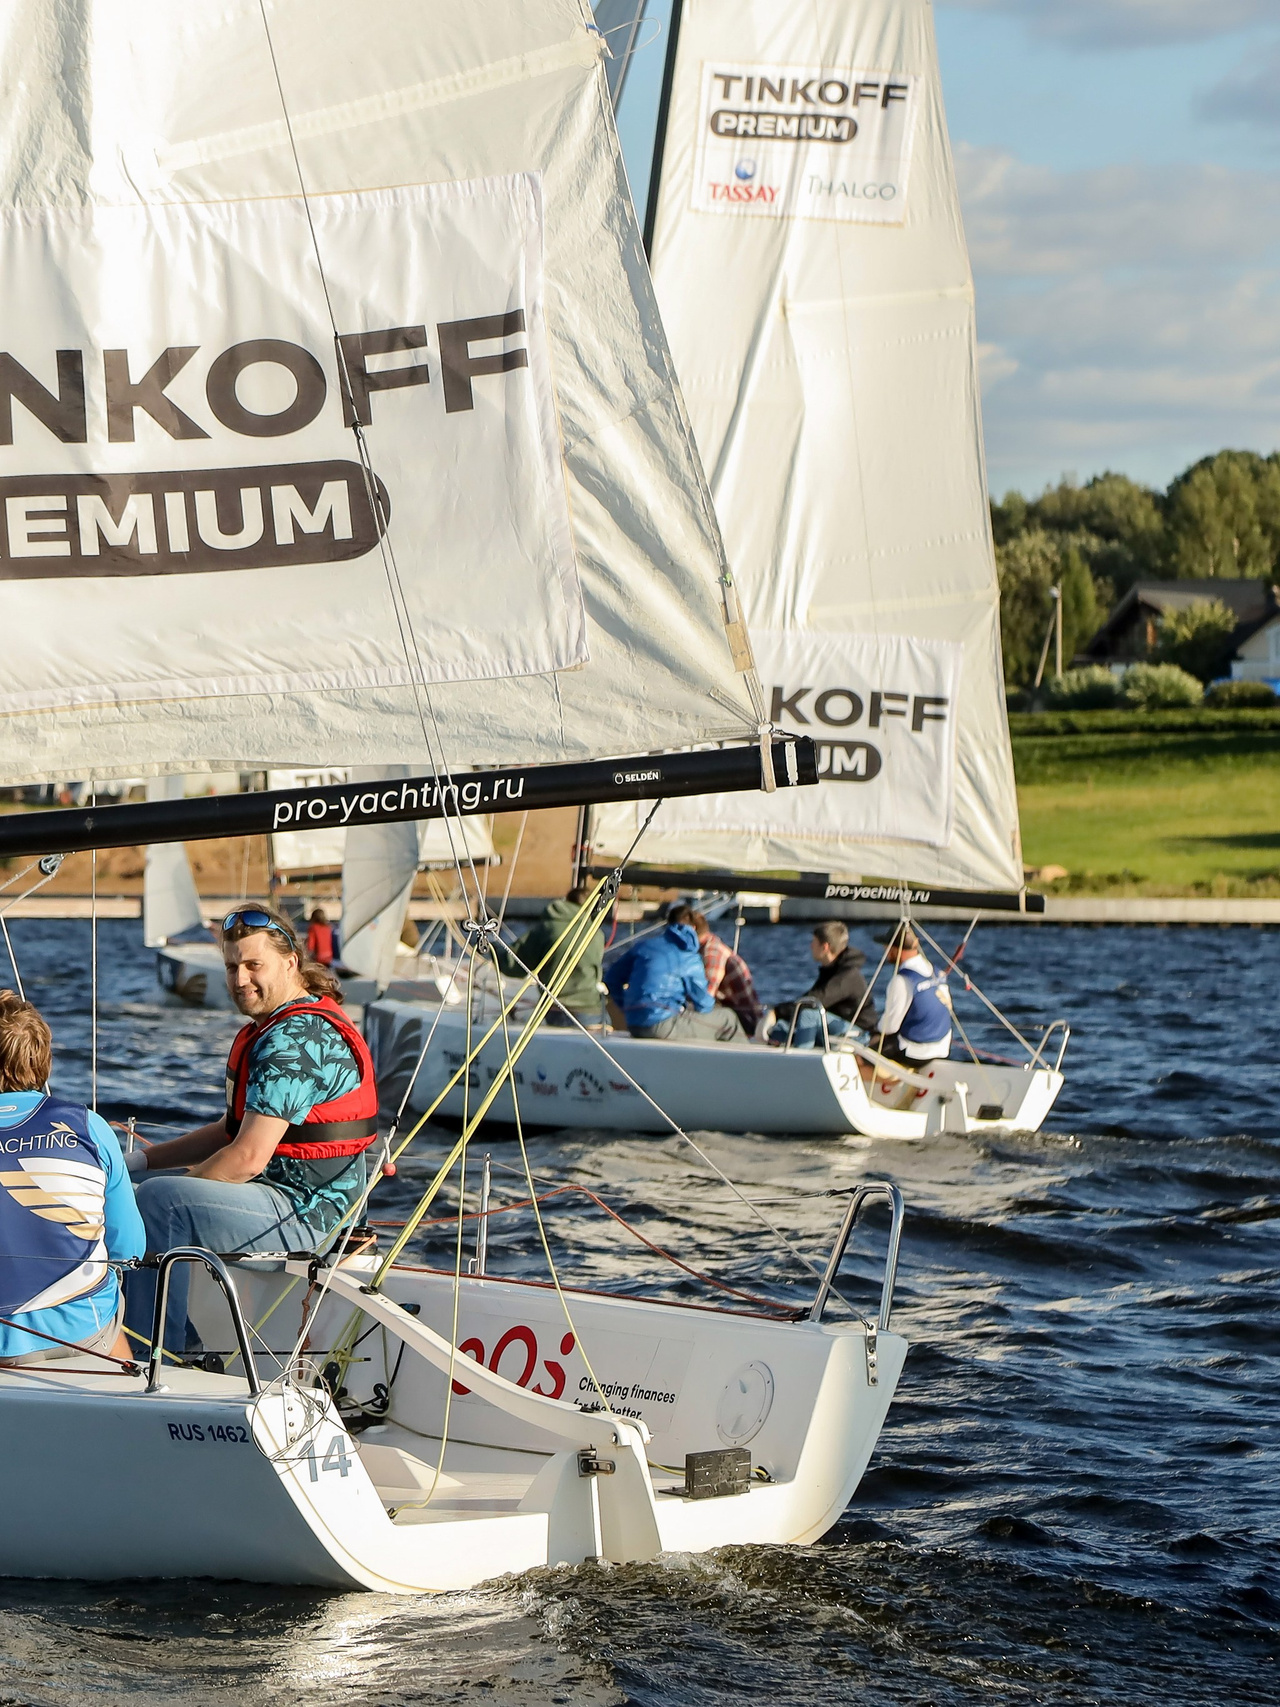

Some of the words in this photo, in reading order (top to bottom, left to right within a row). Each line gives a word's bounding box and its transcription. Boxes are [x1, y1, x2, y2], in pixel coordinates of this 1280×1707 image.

[714, 73, 908, 109] TINKOFF
[717, 111, 850, 140] PREMIUM
[709, 181, 780, 203] TASSAY
[809, 175, 896, 201] THALGO
[770, 686, 949, 732] KOFF
[273, 776, 524, 829] pro-yachting.ru
[825, 884, 930, 903] pro-yachting.ru
[839, 1075, 859, 1091] 21
[630, 1384, 676, 1403] finances
[168, 1423, 205, 1442] RUS
[208, 1425, 249, 1443] 1462
[298, 1435, 352, 1482] 14
